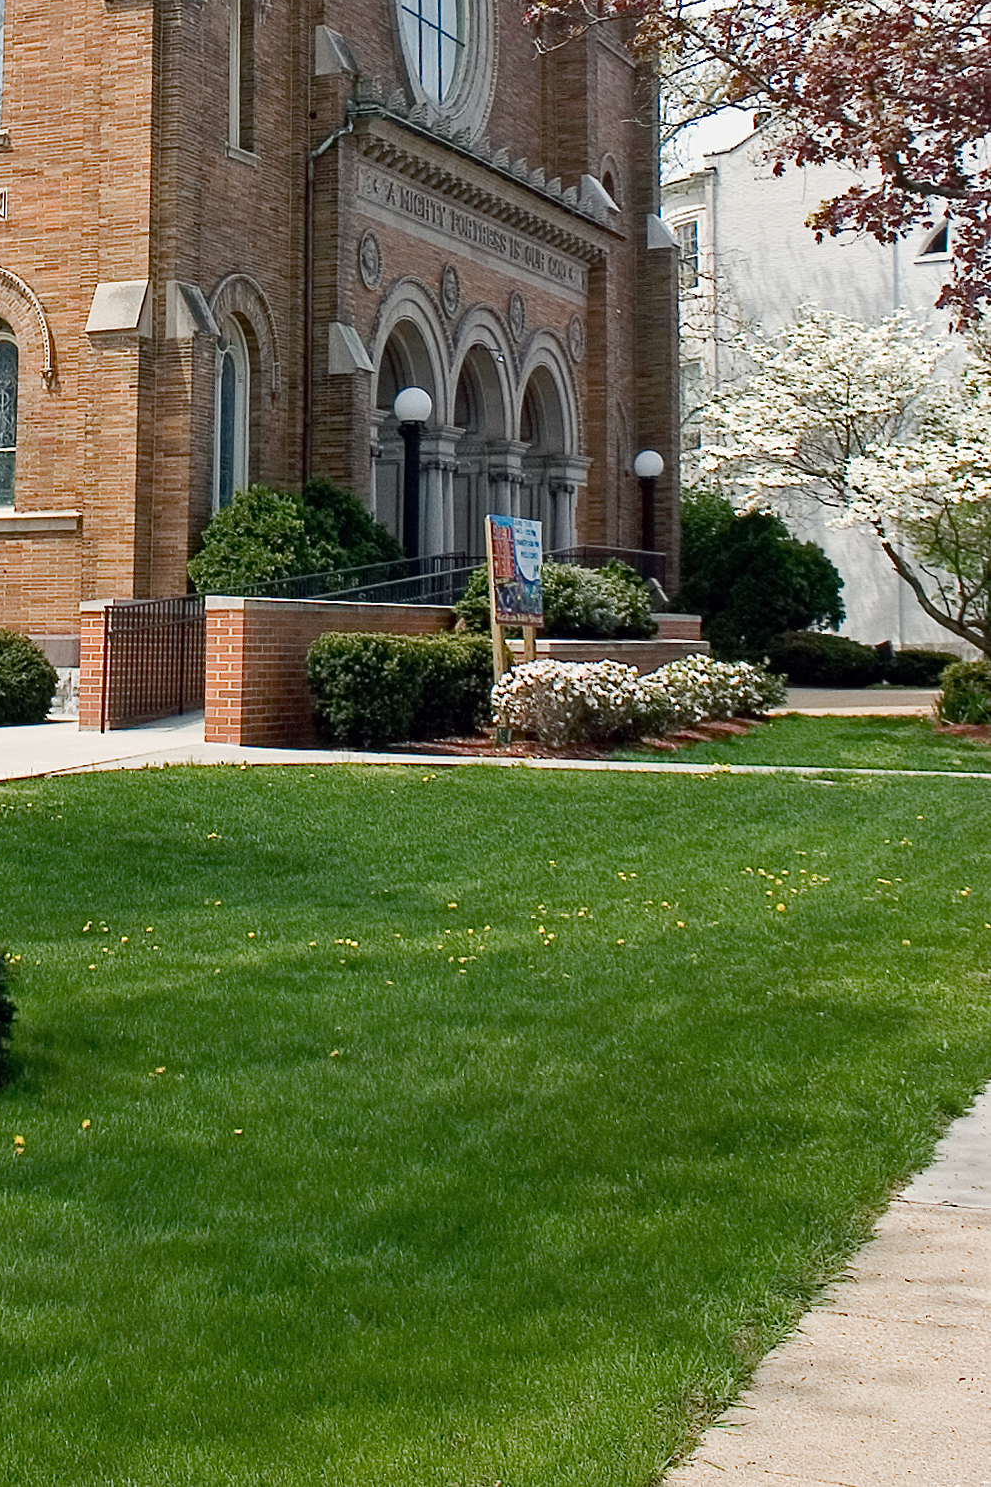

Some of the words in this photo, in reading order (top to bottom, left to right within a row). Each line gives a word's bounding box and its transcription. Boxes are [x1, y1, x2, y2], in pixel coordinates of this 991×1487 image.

[385, 181, 397, 206] A
[399, 186, 446, 228] MIGHTY
[451, 208, 507, 254] FORTRESS
[509, 235, 521, 260] IS
